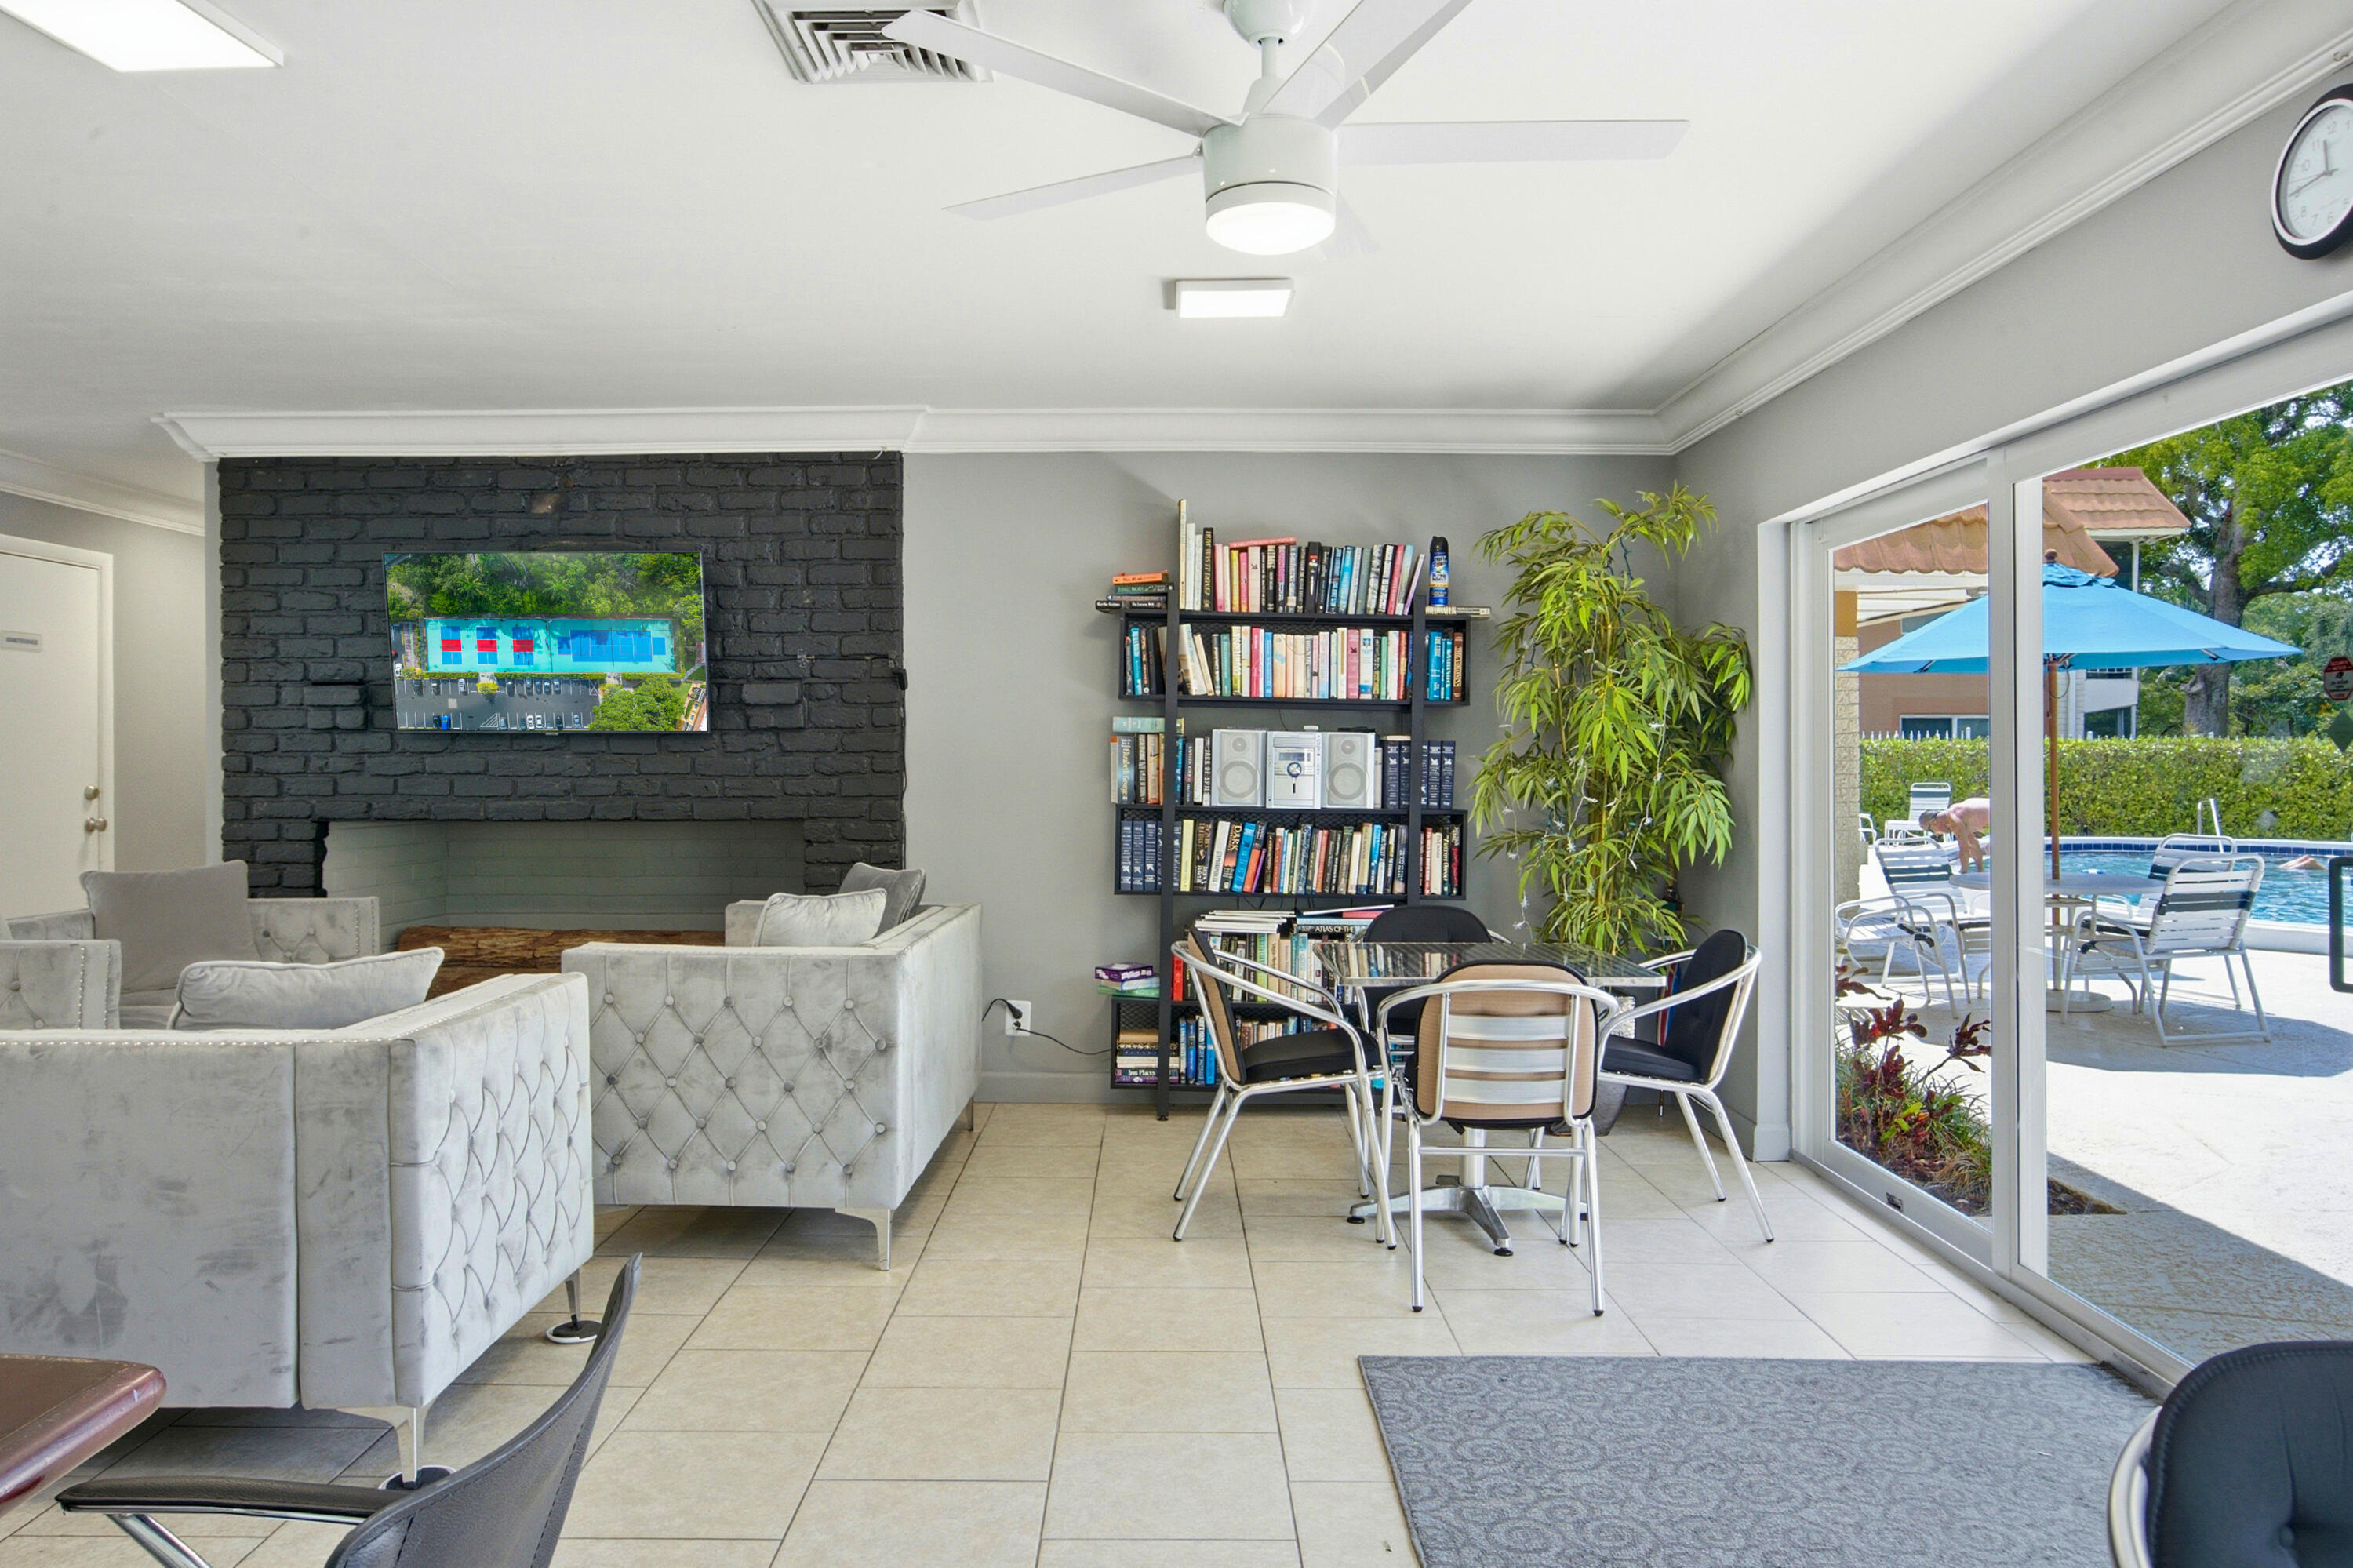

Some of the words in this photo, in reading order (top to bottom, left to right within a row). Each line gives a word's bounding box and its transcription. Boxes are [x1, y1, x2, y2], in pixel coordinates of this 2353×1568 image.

[2327, 121, 2337, 135] 12
[2311, 139, 2320, 151] 11
[2300, 159, 2310, 171] 10
[2300, 206, 2307, 218] 8
[2327, 212, 2333, 224] 6
[2311, 213, 2318, 226] 7
[1122, 748, 1131, 775] Elizabeth
[1120, 776, 1129, 795] George
[1230, 825, 1242, 851] DARK
